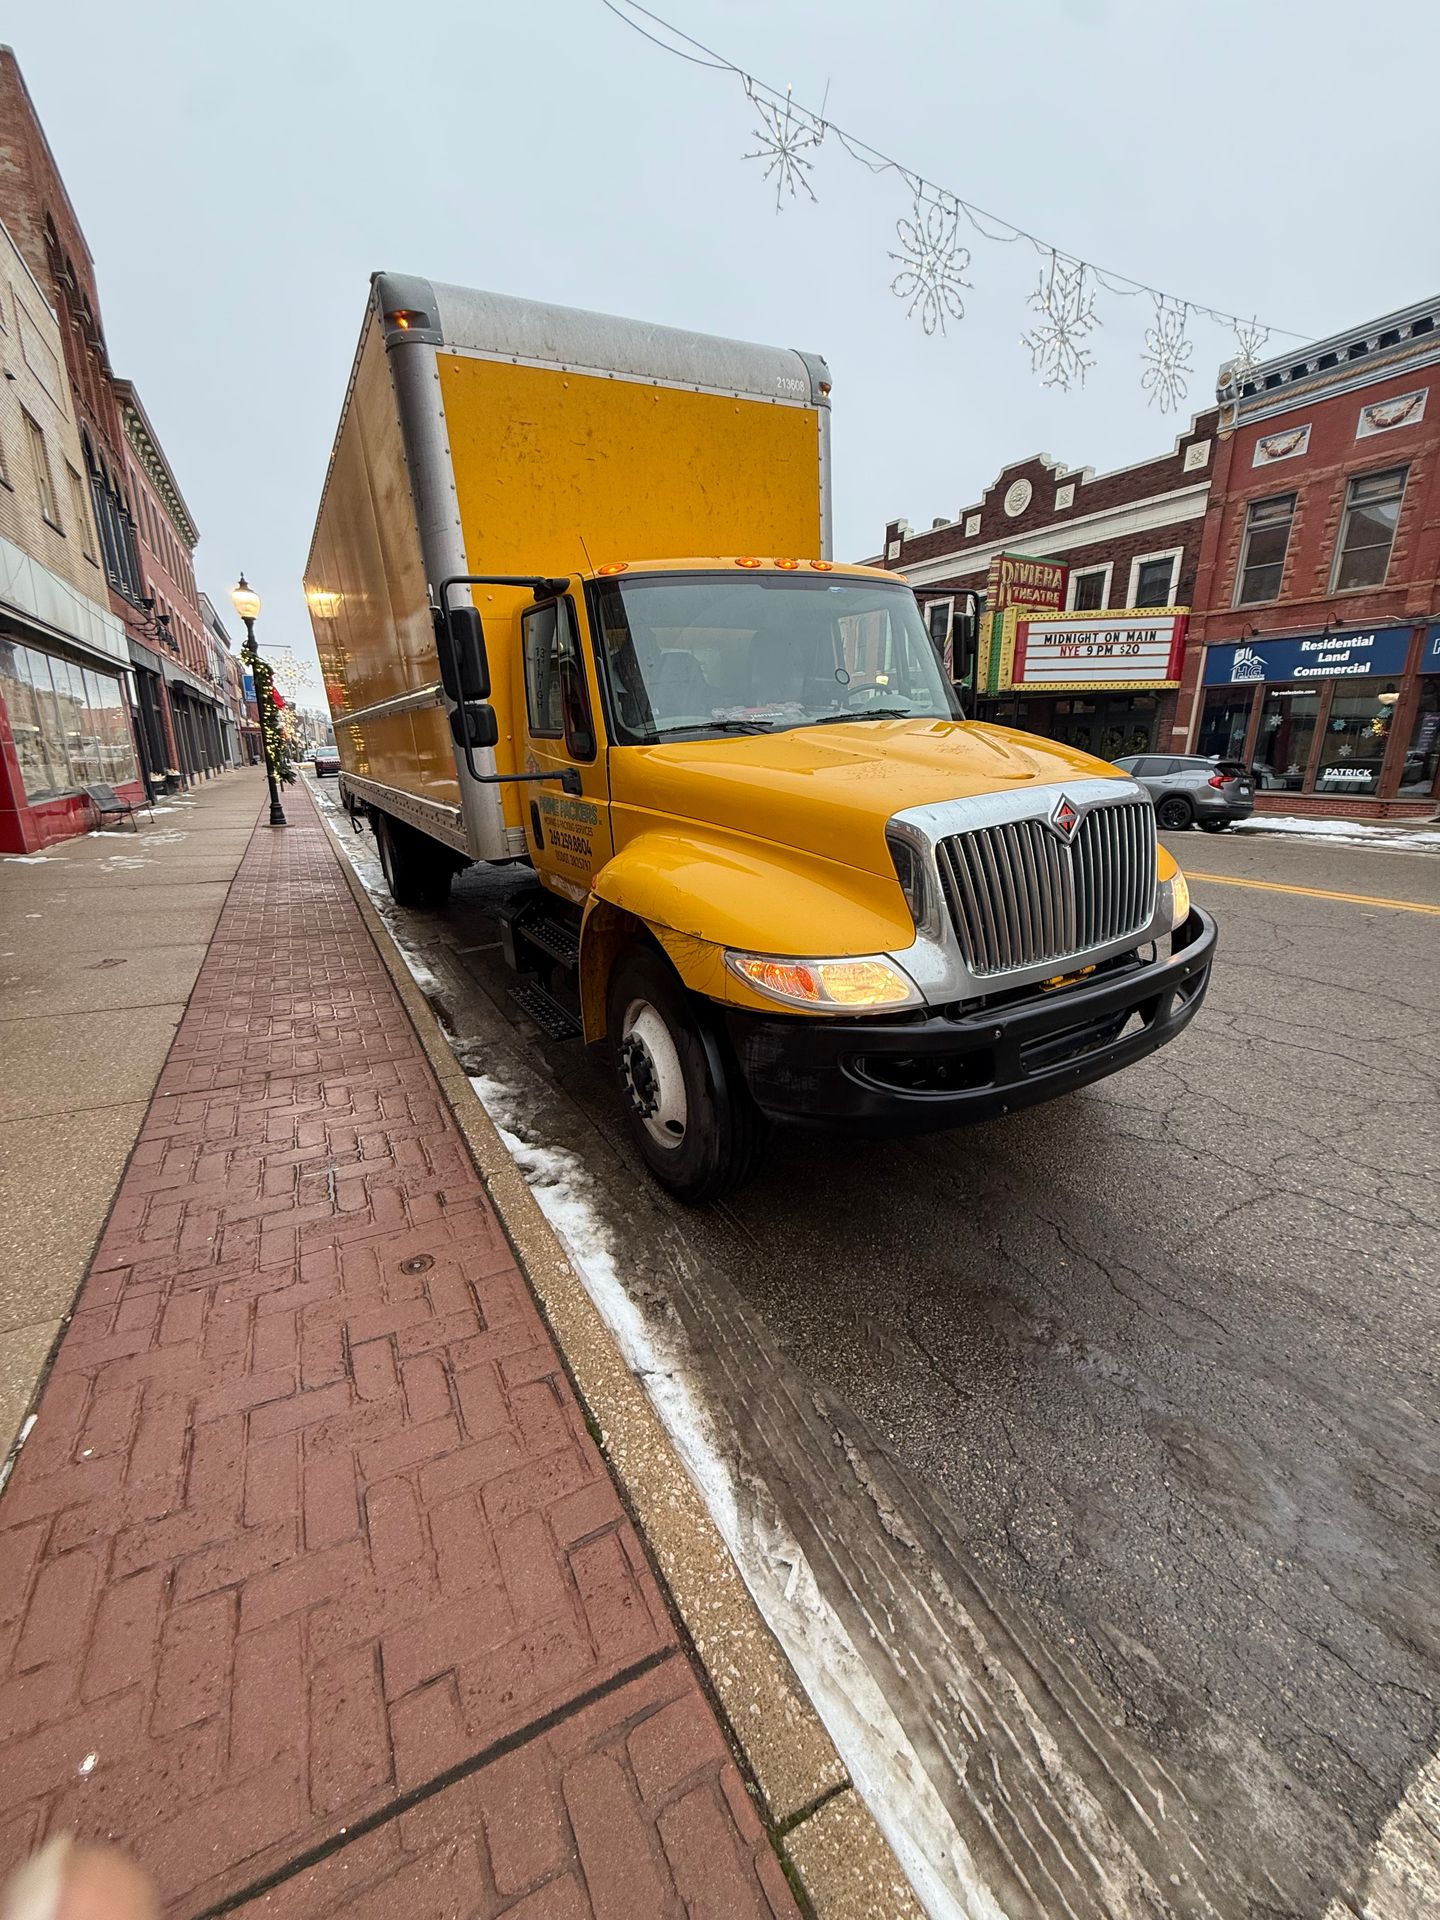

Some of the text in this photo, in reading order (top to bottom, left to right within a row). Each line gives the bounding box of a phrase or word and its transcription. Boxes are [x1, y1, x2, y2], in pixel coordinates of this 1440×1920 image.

[999, 560, 1063, 606] RIVIERA
[1012, 586, 1061, 604] THEATRE
[1044, 630, 1157, 645] MIDNIGHT ON MAIN
[1301, 635, 1375, 652] Residential
[1059, 644, 1140, 657] NYE 9 PM $20
[1317, 650, 1350, 663] Land
[1293, 662, 1371, 677] Commercial
[1325, 768, 1373, 777] PATRICK
[560, 799, 598, 826] PACKERS
